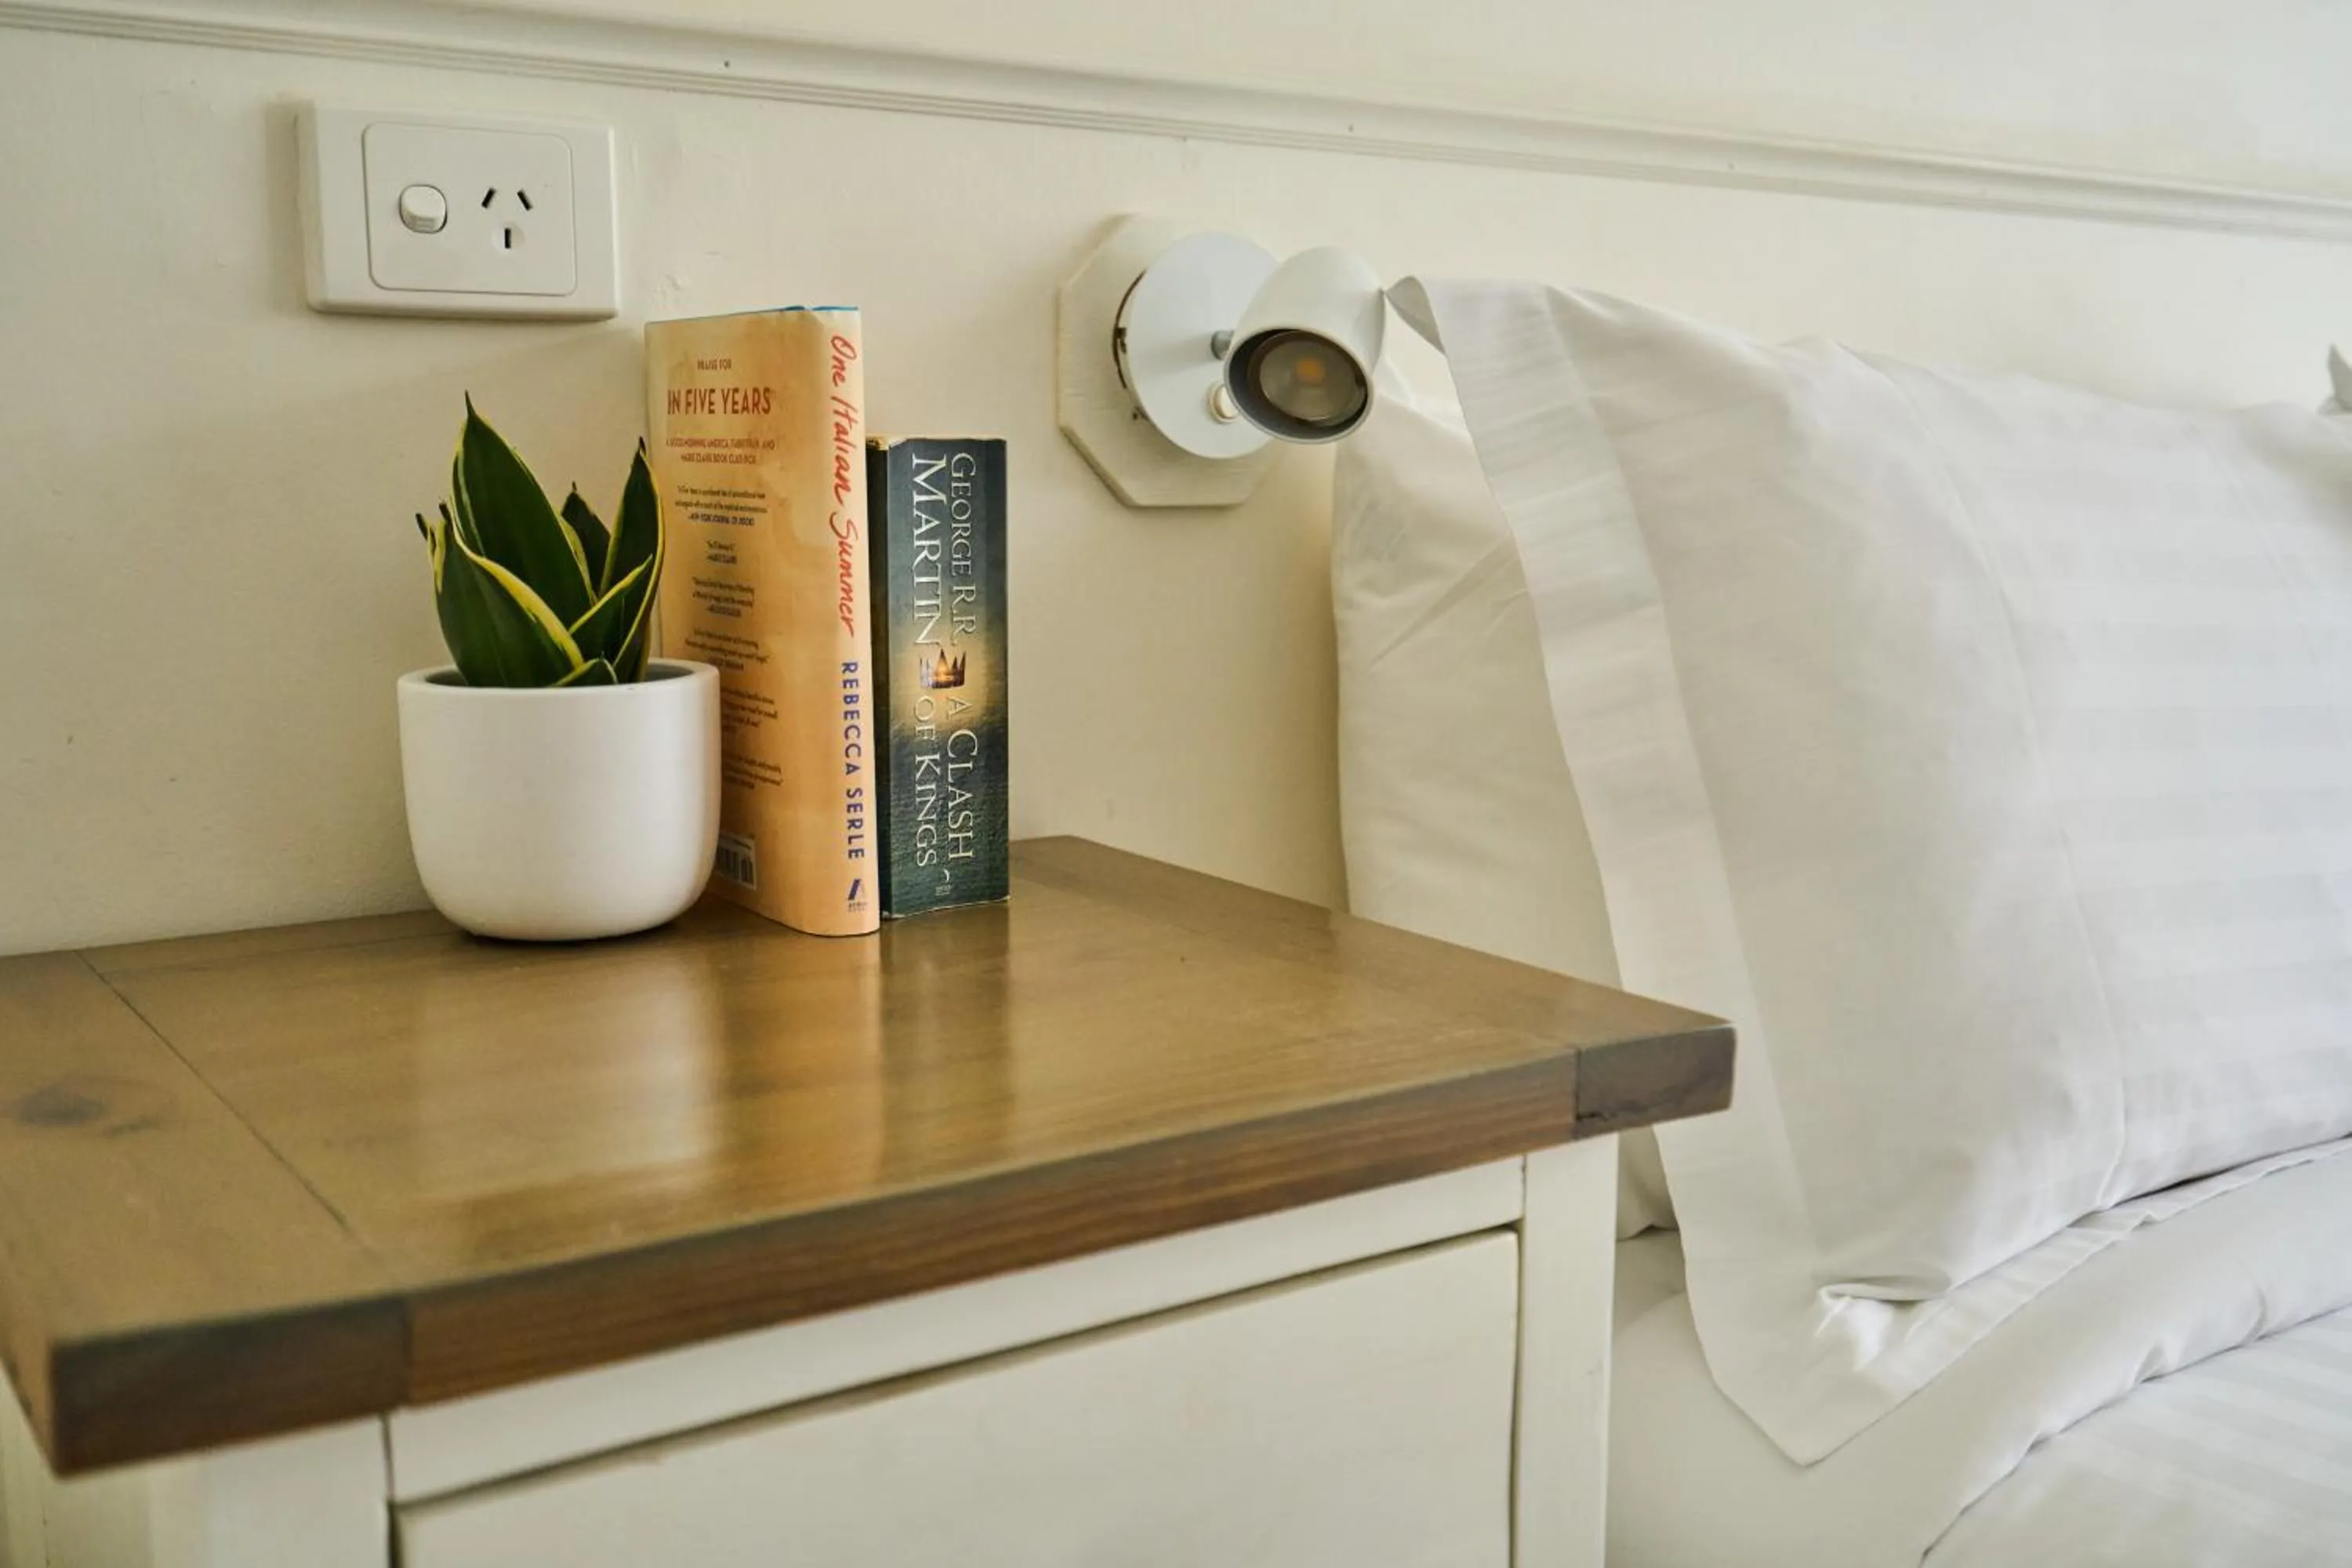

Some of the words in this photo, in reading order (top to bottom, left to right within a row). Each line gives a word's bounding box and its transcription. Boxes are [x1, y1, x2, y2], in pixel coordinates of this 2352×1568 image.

[667, 388, 681, 415] IN
[684, 387, 716, 415] FIVE
[720, 386, 771, 415] YEARS
[830, 336, 857, 387] One
[830, 396, 858, 506] Italian
[912, 452, 947, 645] MARTIN
[950, 452, 977, 576] GEORGE
[829, 511, 858, 638] Summer
[841, 662, 862, 775] REBECCA
[914, 695, 935, 741] OF
[947, 695, 973, 717] A
[846, 787, 865, 860] SERLE
[914, 752, 941, 866] KINGS
[946, 728, 978, 861] CLASH
